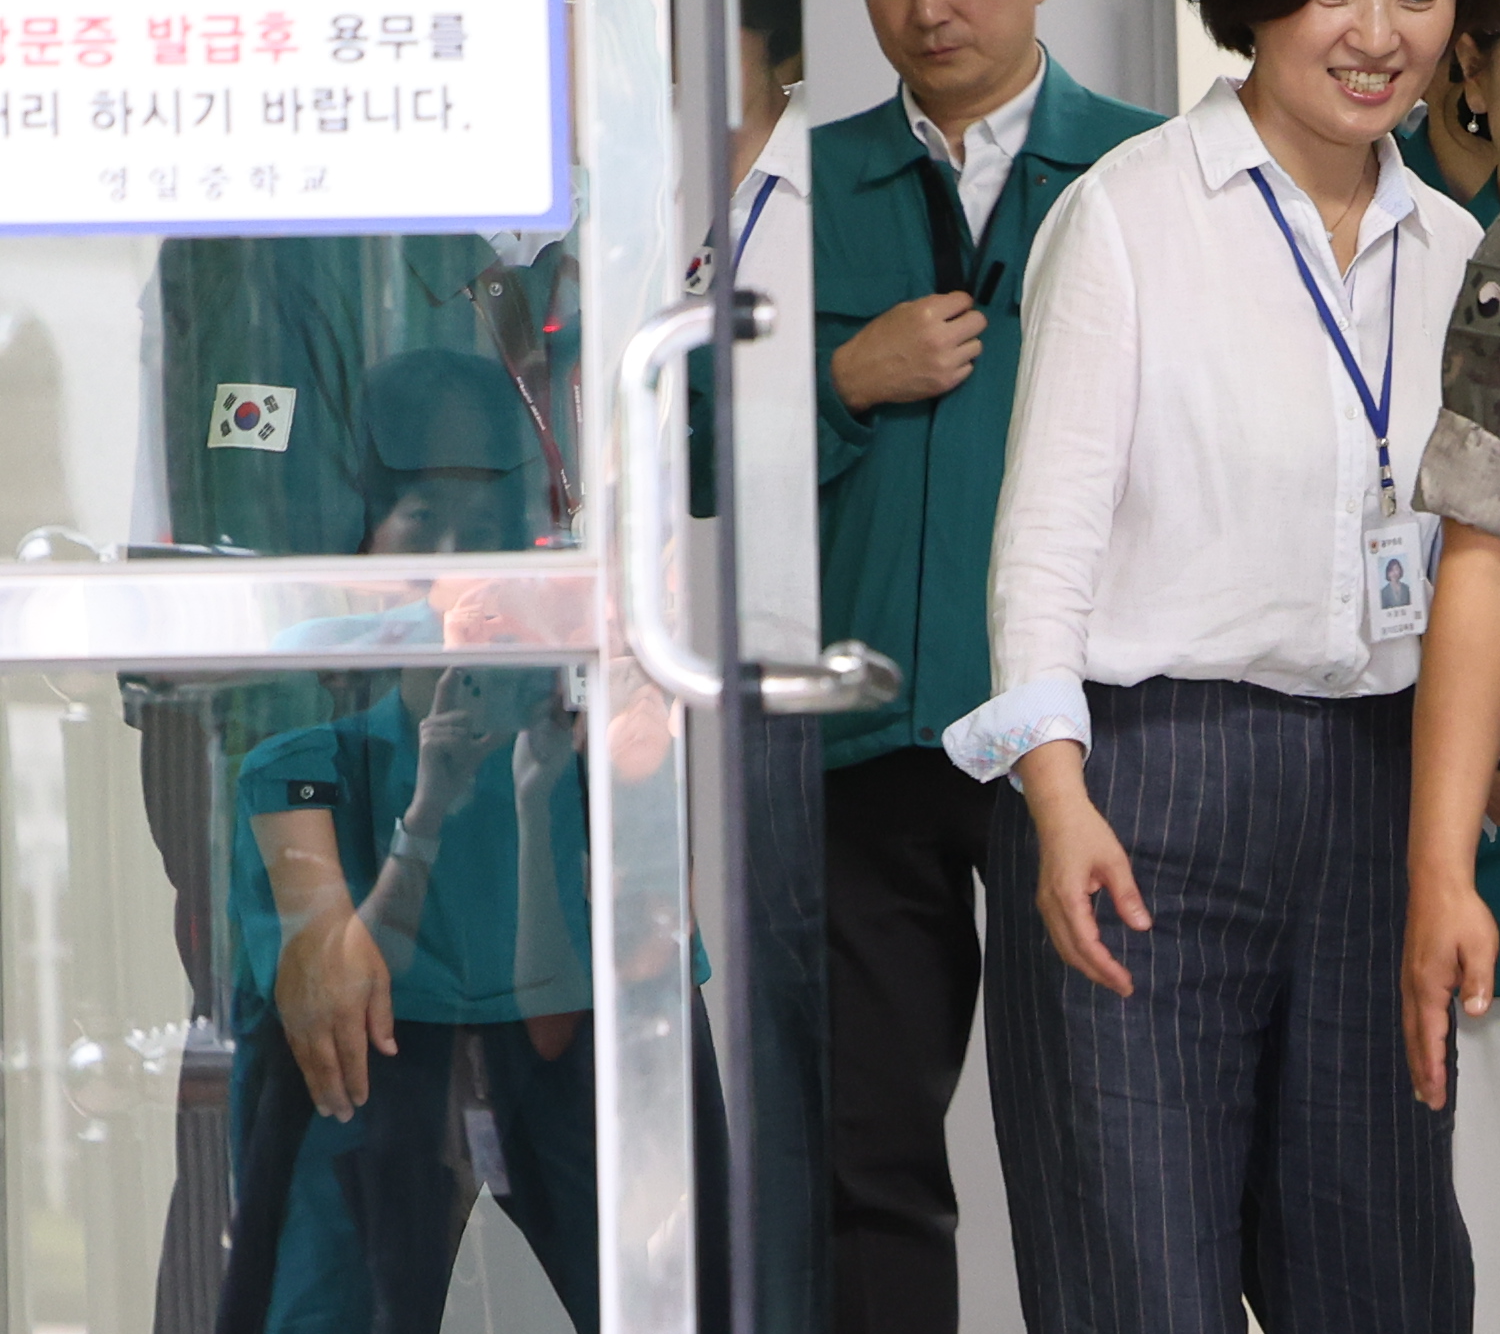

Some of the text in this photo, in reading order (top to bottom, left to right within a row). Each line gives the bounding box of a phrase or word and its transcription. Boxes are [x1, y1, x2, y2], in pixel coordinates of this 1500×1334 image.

[0, 9, 470, 68] 문증 발급후 용무를
[0, 84, 474, 138] 리 하시기 바랍니다.
